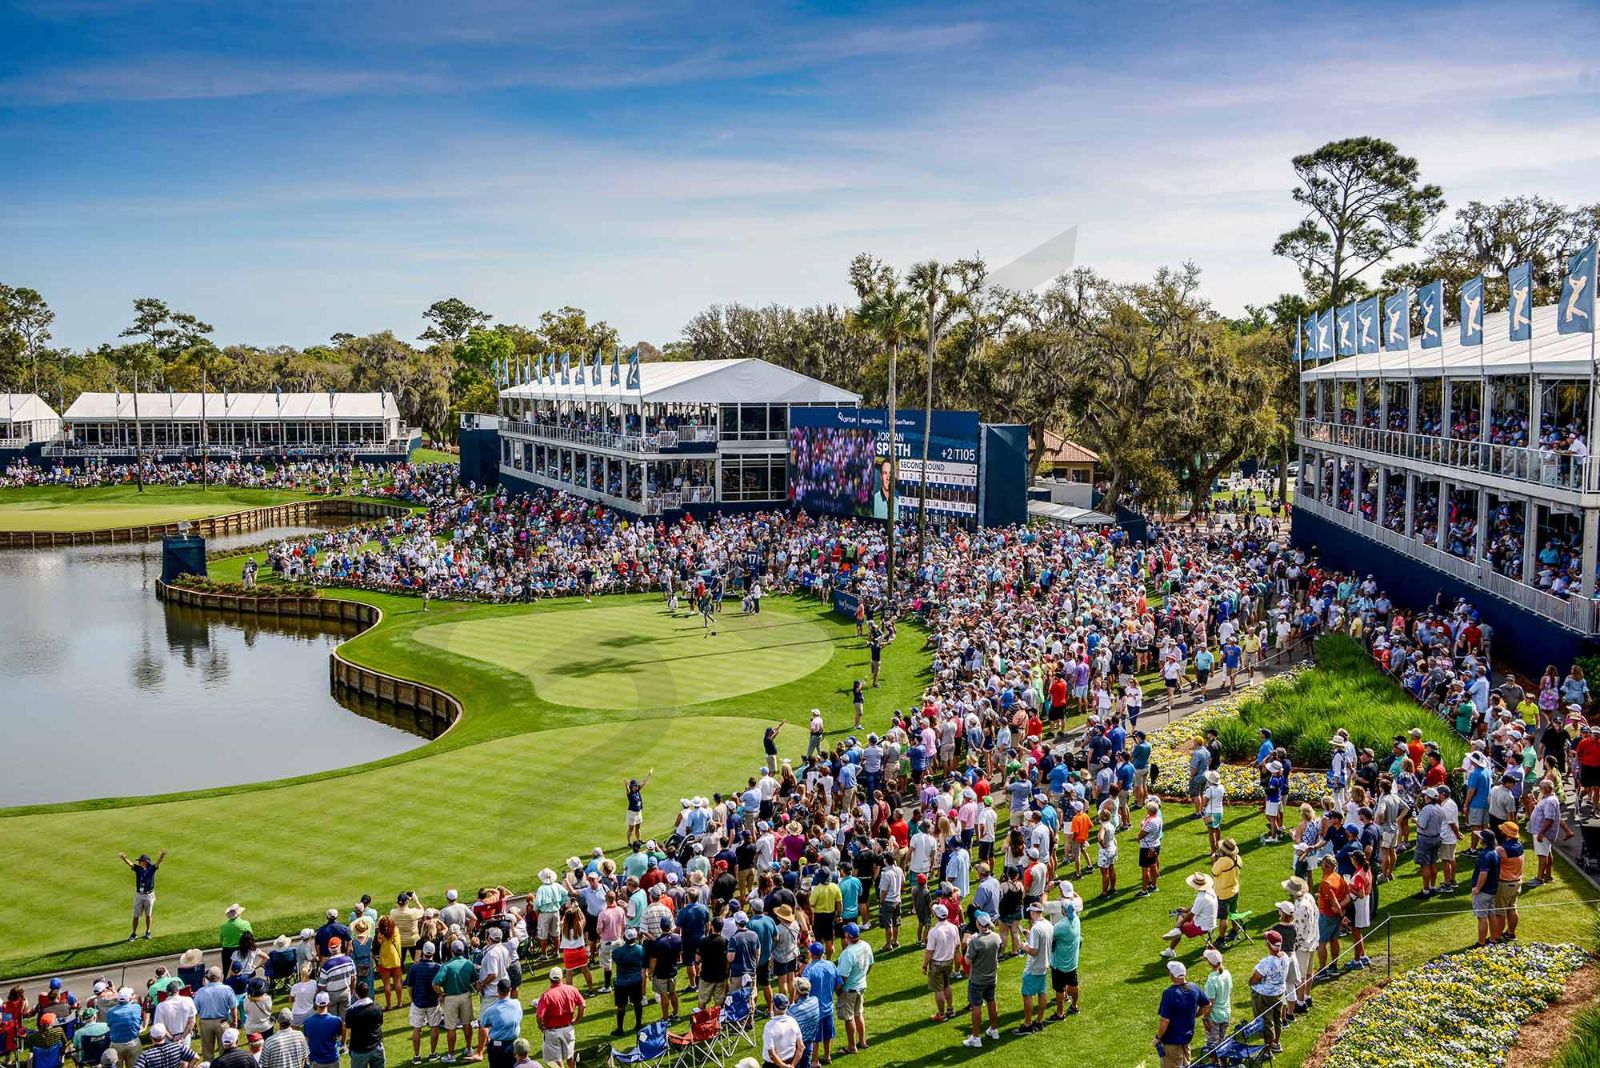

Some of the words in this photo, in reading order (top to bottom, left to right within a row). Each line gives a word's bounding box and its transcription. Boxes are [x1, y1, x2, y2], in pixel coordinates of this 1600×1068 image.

[877, 432, 904, 442] JORAN
[942, 448, 952, 460] +2
[901, 461, 922, 470] SECOND
[748, 554, 756, 564] 17
